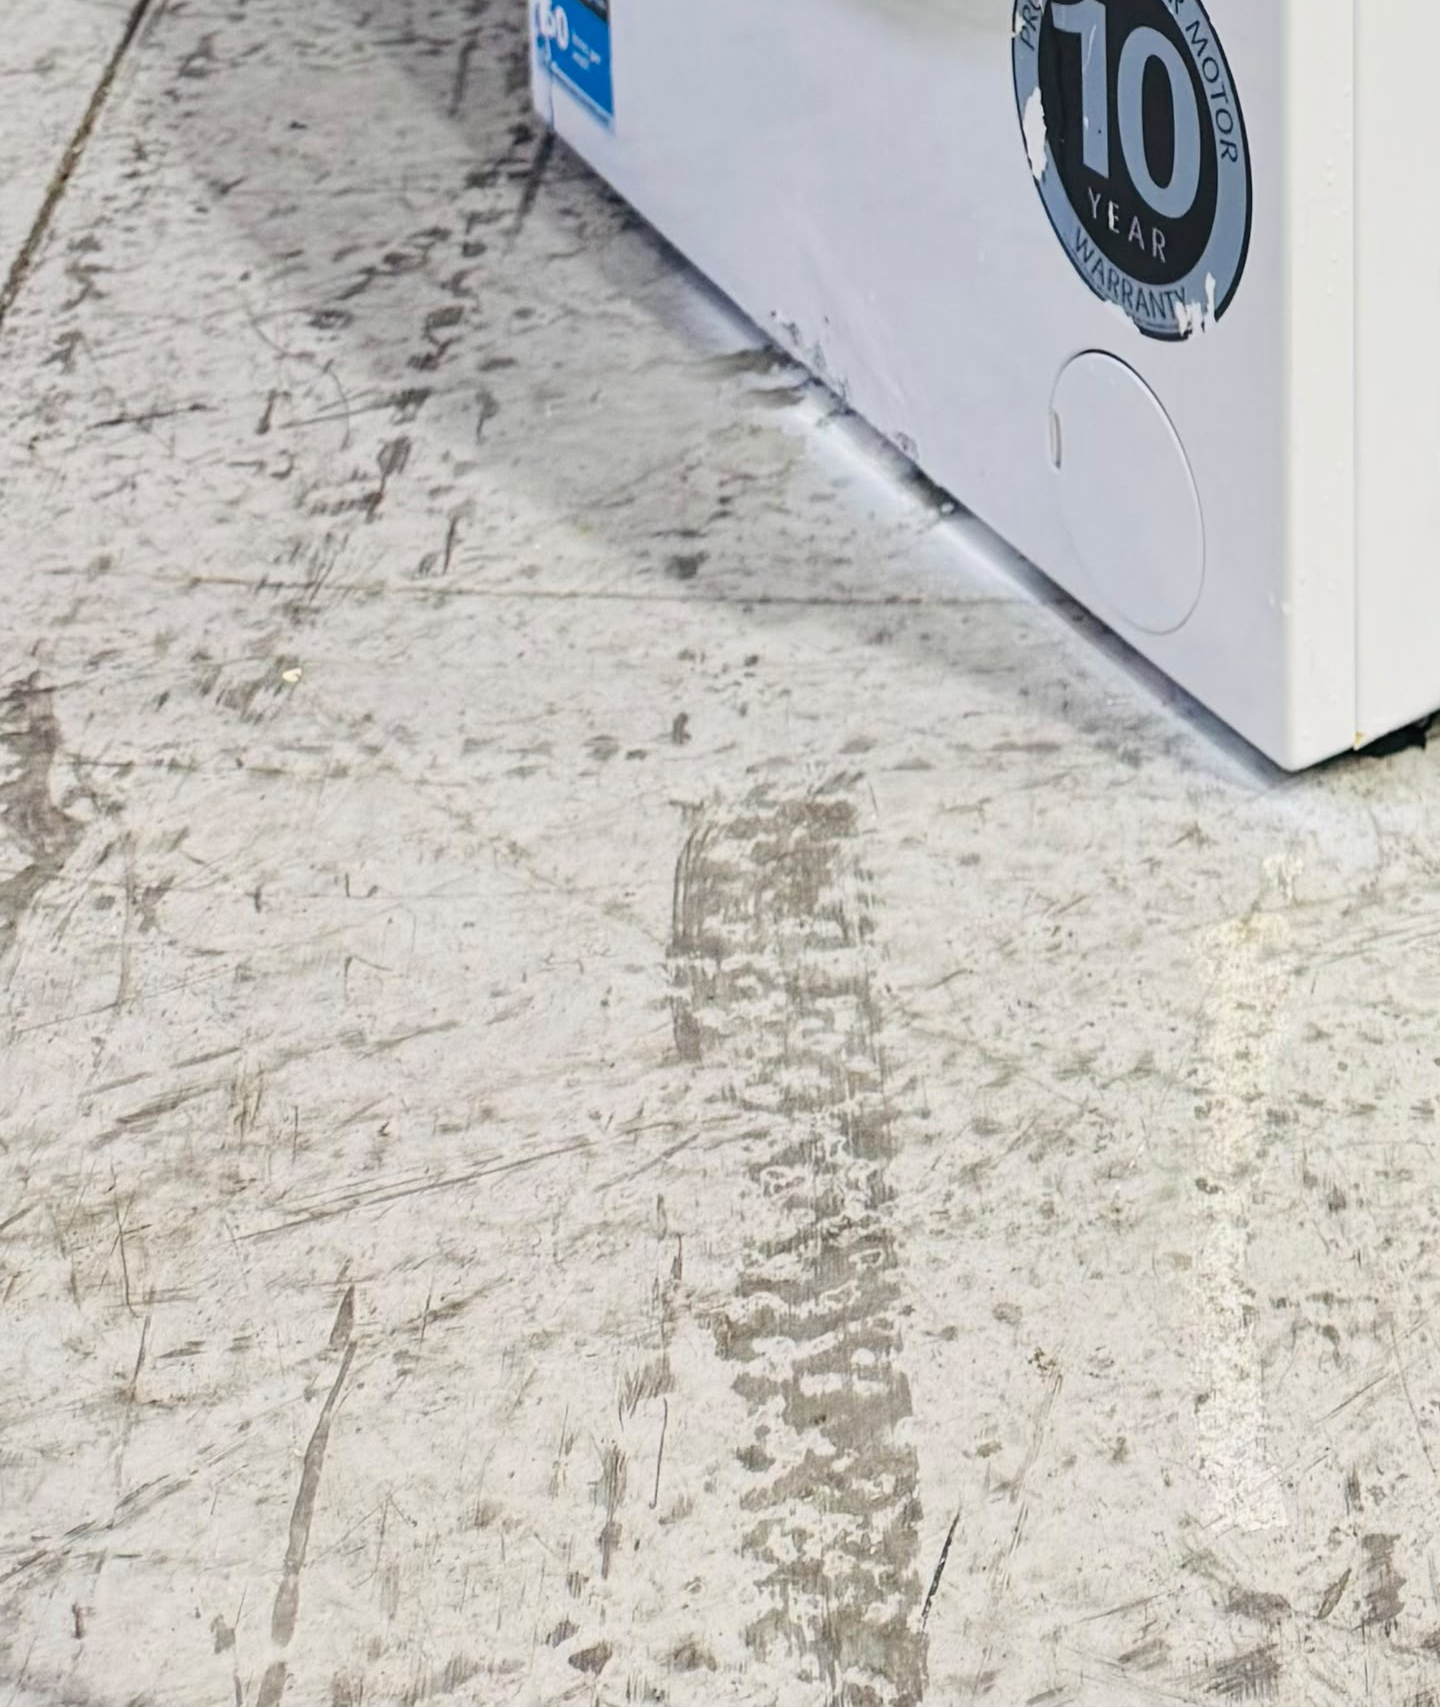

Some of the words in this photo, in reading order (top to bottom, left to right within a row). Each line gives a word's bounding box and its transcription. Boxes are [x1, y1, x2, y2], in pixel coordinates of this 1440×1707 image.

[1184, 18, 1240, 164] MOTOR
[1087, 185, 1168, 265] YEAR
[1073, 226, 1187, 321] WARRANTY
